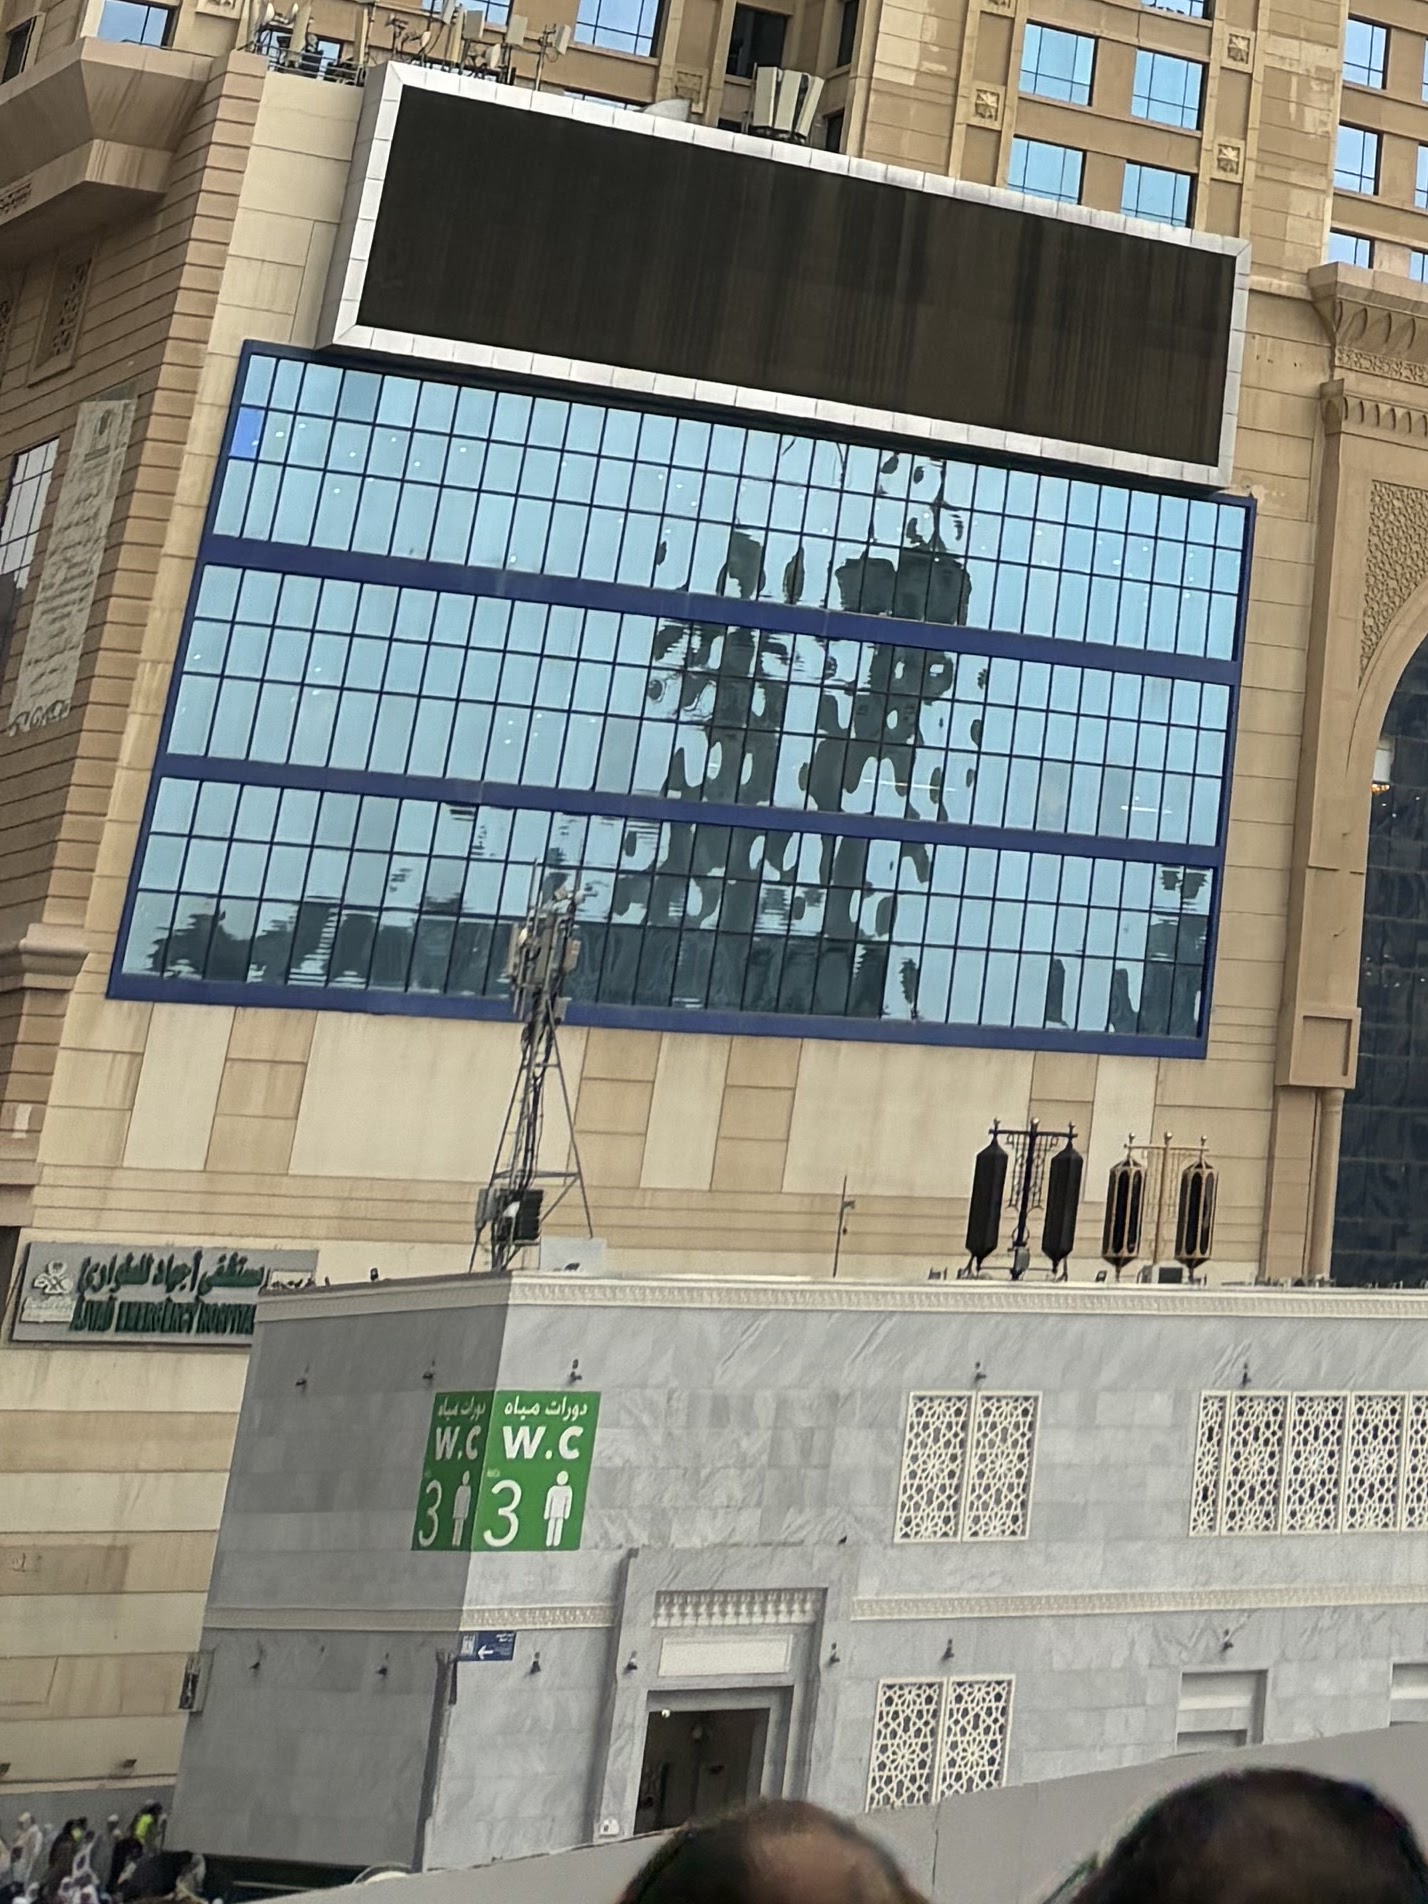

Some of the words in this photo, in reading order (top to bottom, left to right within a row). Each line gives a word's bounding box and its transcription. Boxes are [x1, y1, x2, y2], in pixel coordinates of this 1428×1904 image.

[504, 1395, 540, 1420] مياه
[544, 1395, 588, 1421] دورات
[434, 1425, 482, 1460] W.C
[502, 1425, 584, 1460] W.C
[418, 1479, 442, 1547] 3
[483, 1479, 522, 1547] 3
